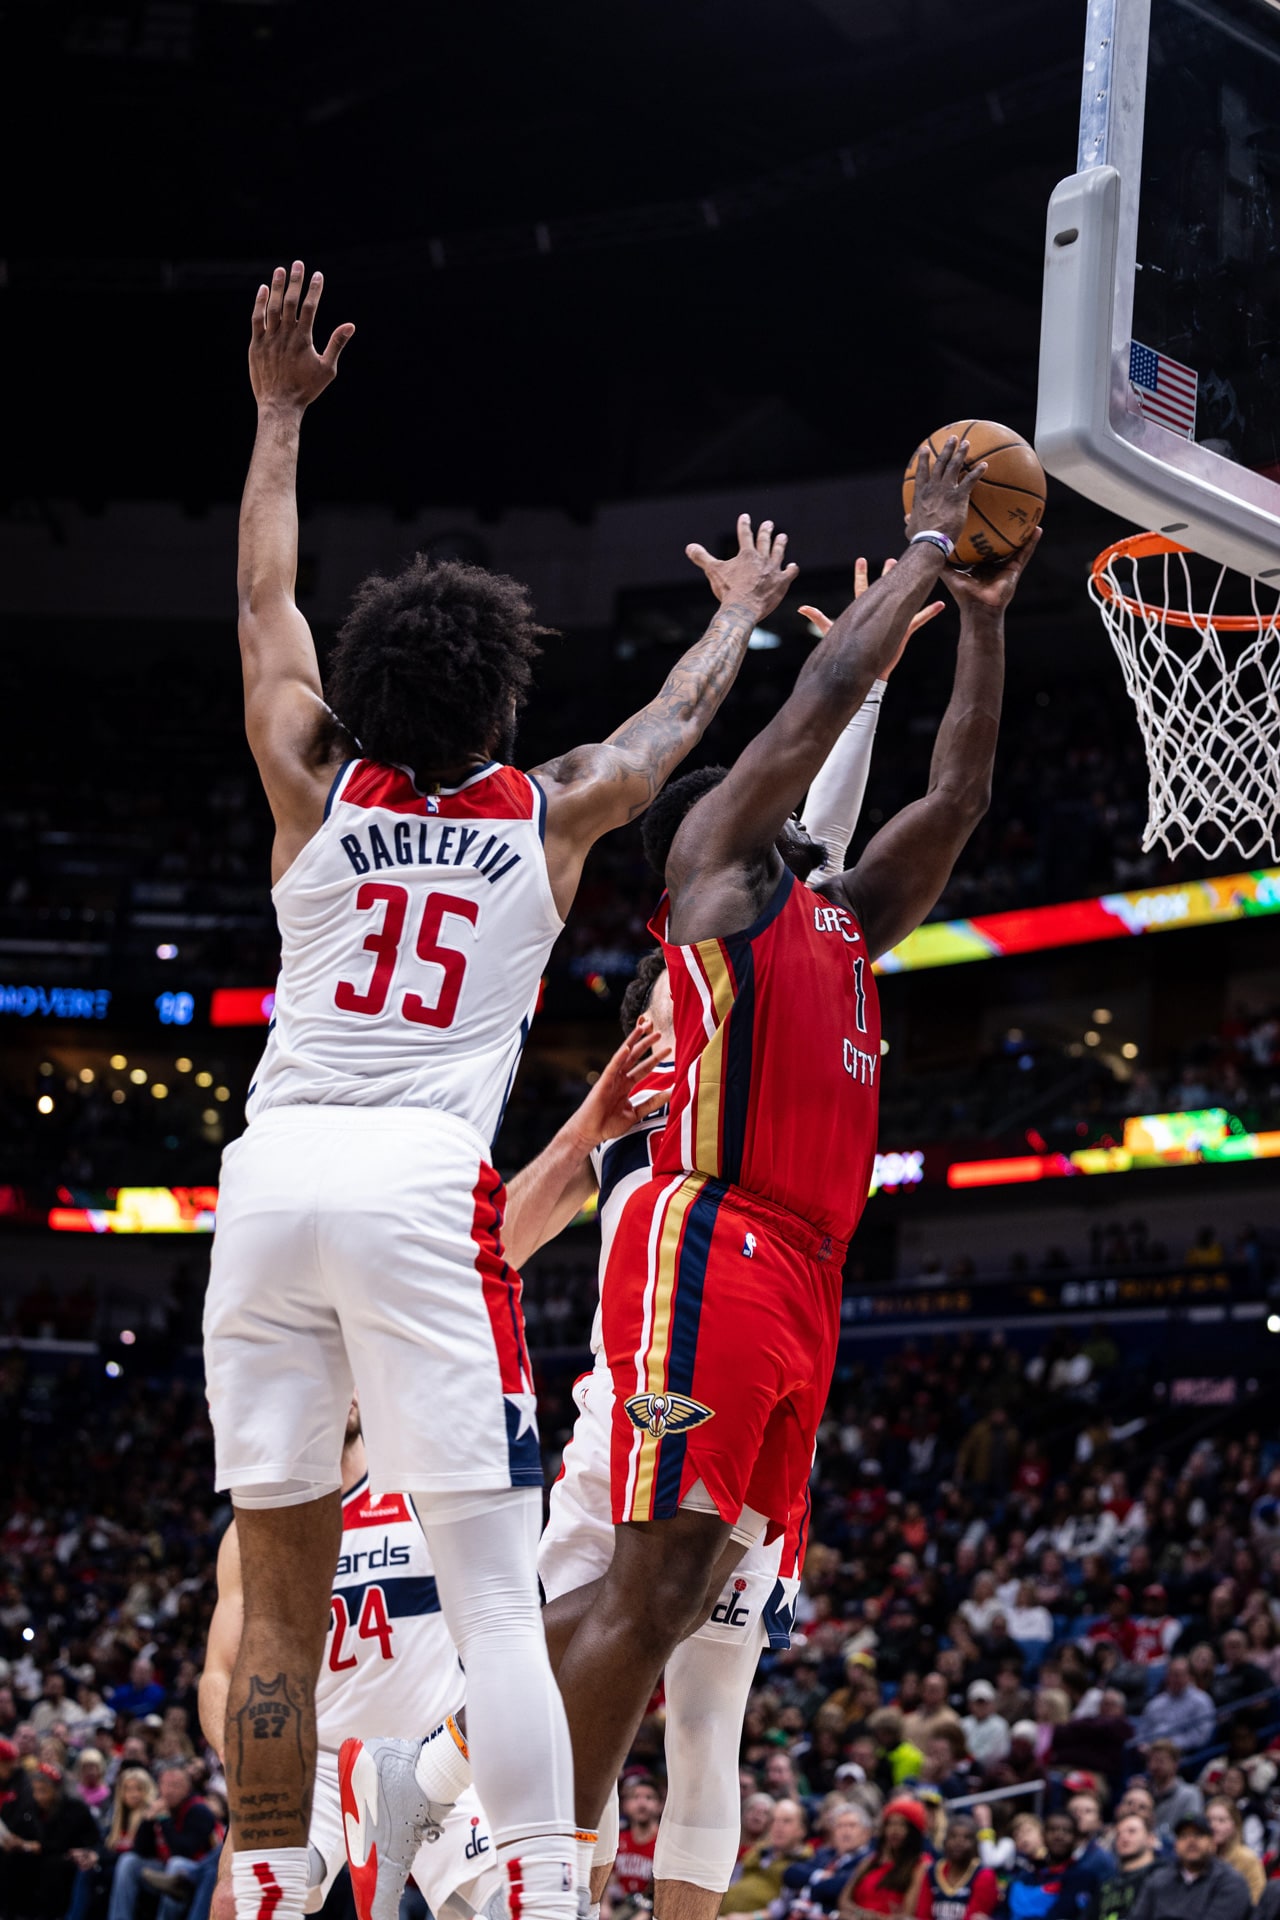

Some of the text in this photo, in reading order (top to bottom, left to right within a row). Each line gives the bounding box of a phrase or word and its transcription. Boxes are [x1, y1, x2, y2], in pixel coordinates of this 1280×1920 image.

[340, 821, 522, 884] BAGLEY III
[334, 882, 480, 1029] 35
[852, 956, 868, 1033] 1
[842, 1037, 878, 1087] CITY
[329, 1587, 394, 1673] 24
[710, 1586, 750, 1627] dc
[253, 1716, 287, 1739] 27
[465, 1824, 490, 1860] dc
